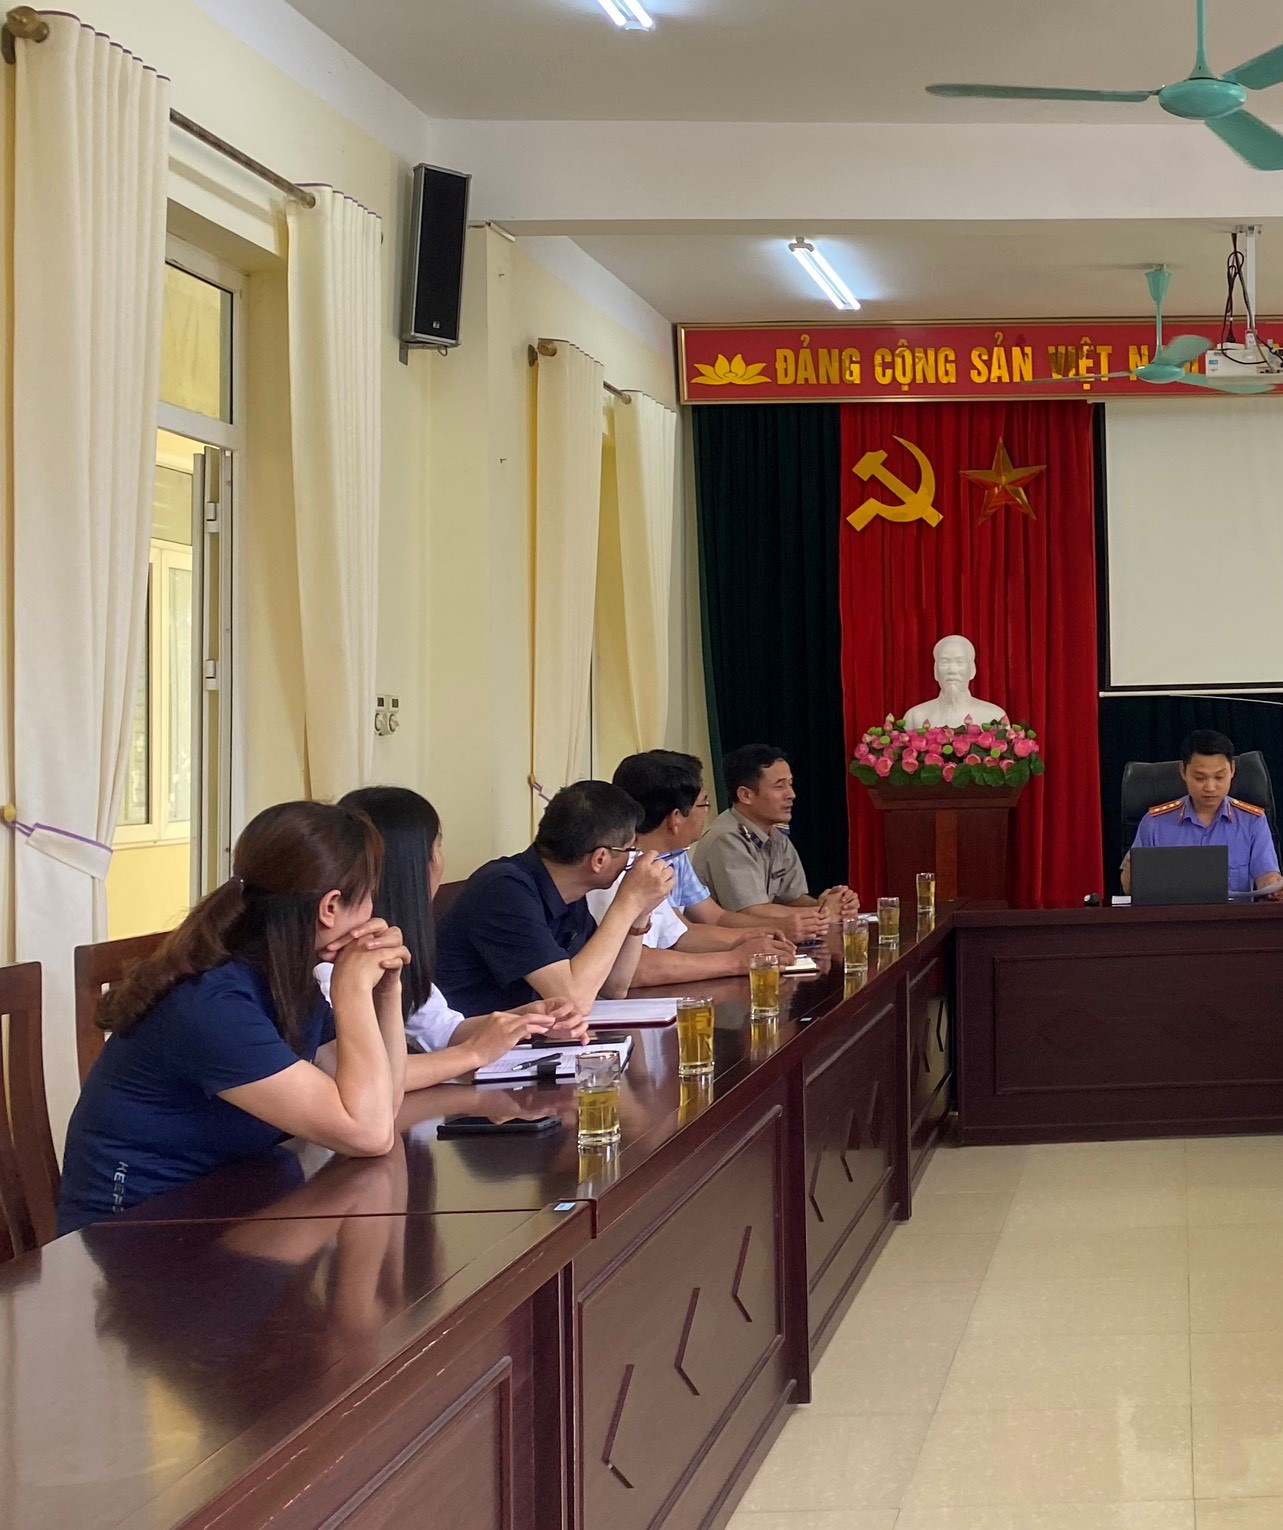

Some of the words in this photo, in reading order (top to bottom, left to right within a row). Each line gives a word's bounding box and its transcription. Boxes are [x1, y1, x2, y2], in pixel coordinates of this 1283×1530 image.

[775, 334, 861, 385] ĐẢNG
[874, 339, 957, 391] CỘNG
[970, 331, 1033, 383] SẢN
[1047, 336, 1113, 389] VIỆT
